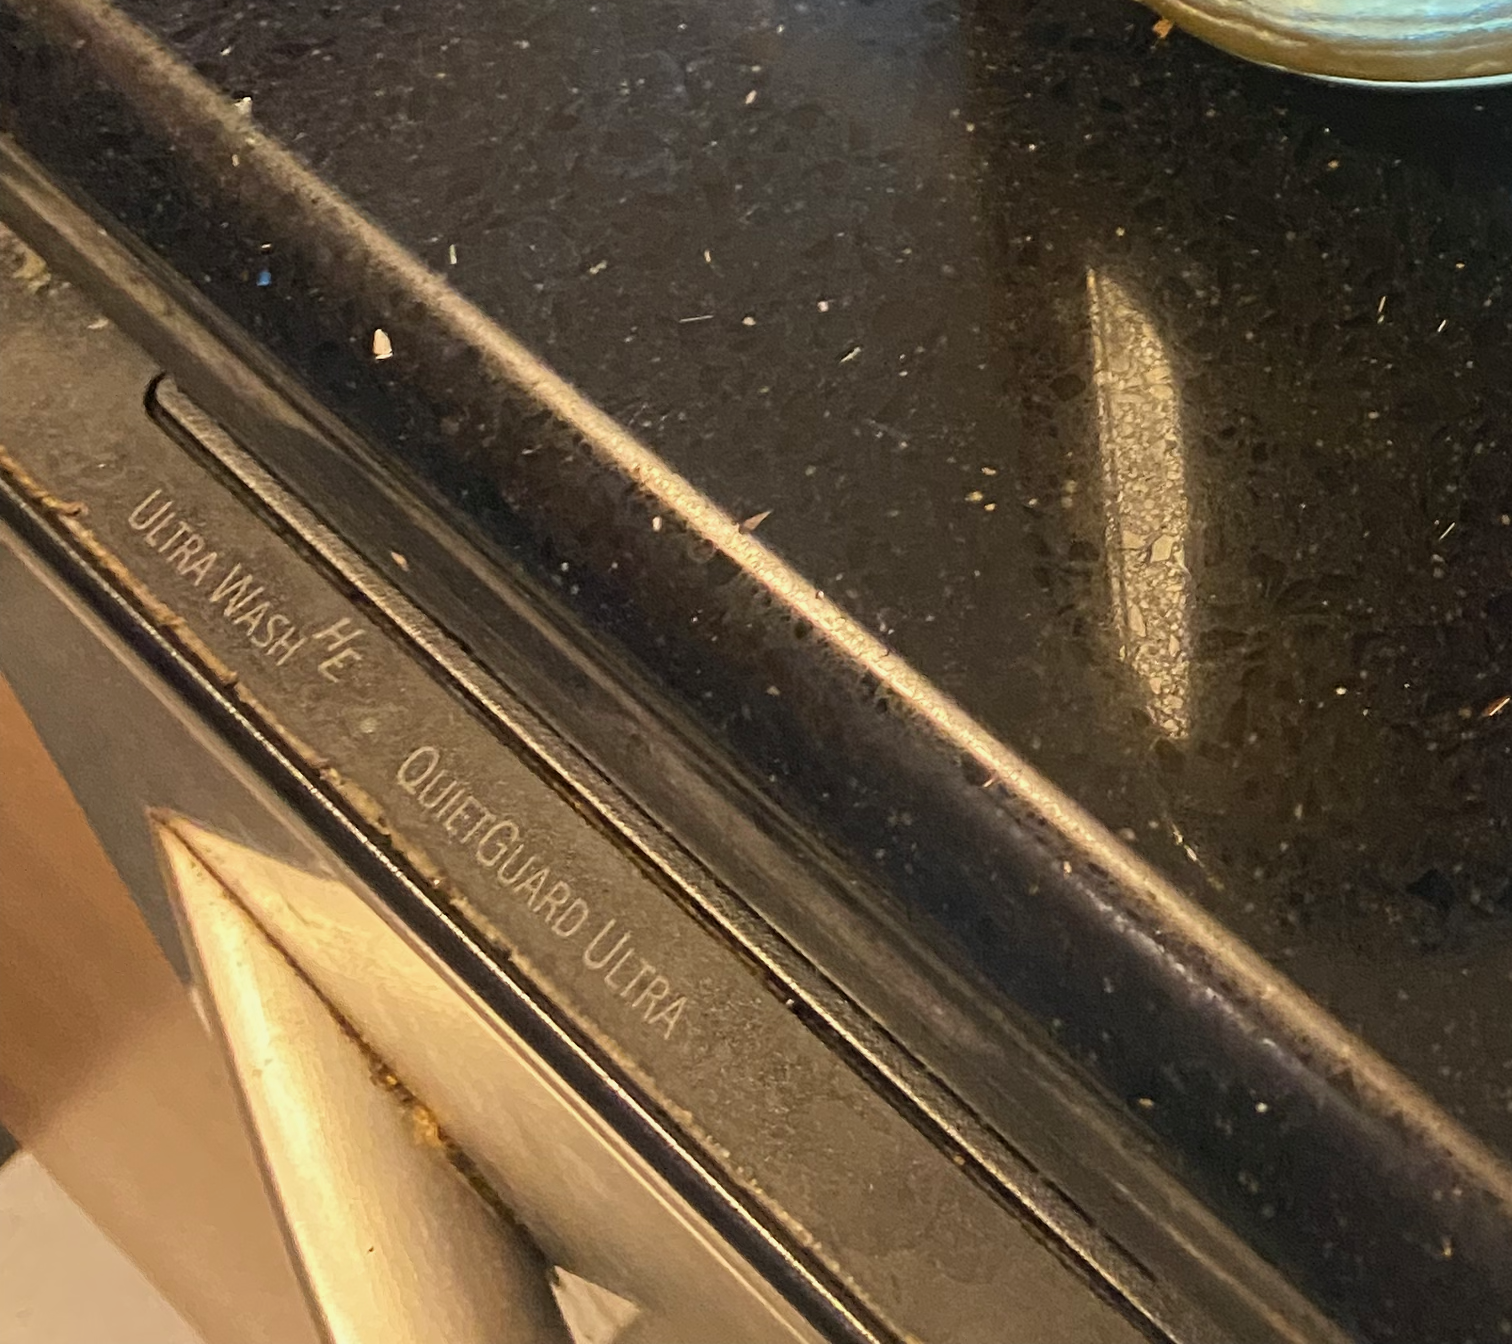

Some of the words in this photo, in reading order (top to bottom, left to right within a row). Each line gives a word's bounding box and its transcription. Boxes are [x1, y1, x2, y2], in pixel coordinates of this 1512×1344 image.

[128, 488, 218, 587] ULTRA
[209, 562, 308, 667] WASH
[396, 745, 589, 938] QUIETGUARD
[583, 918, 688, 1041] ULTRA
